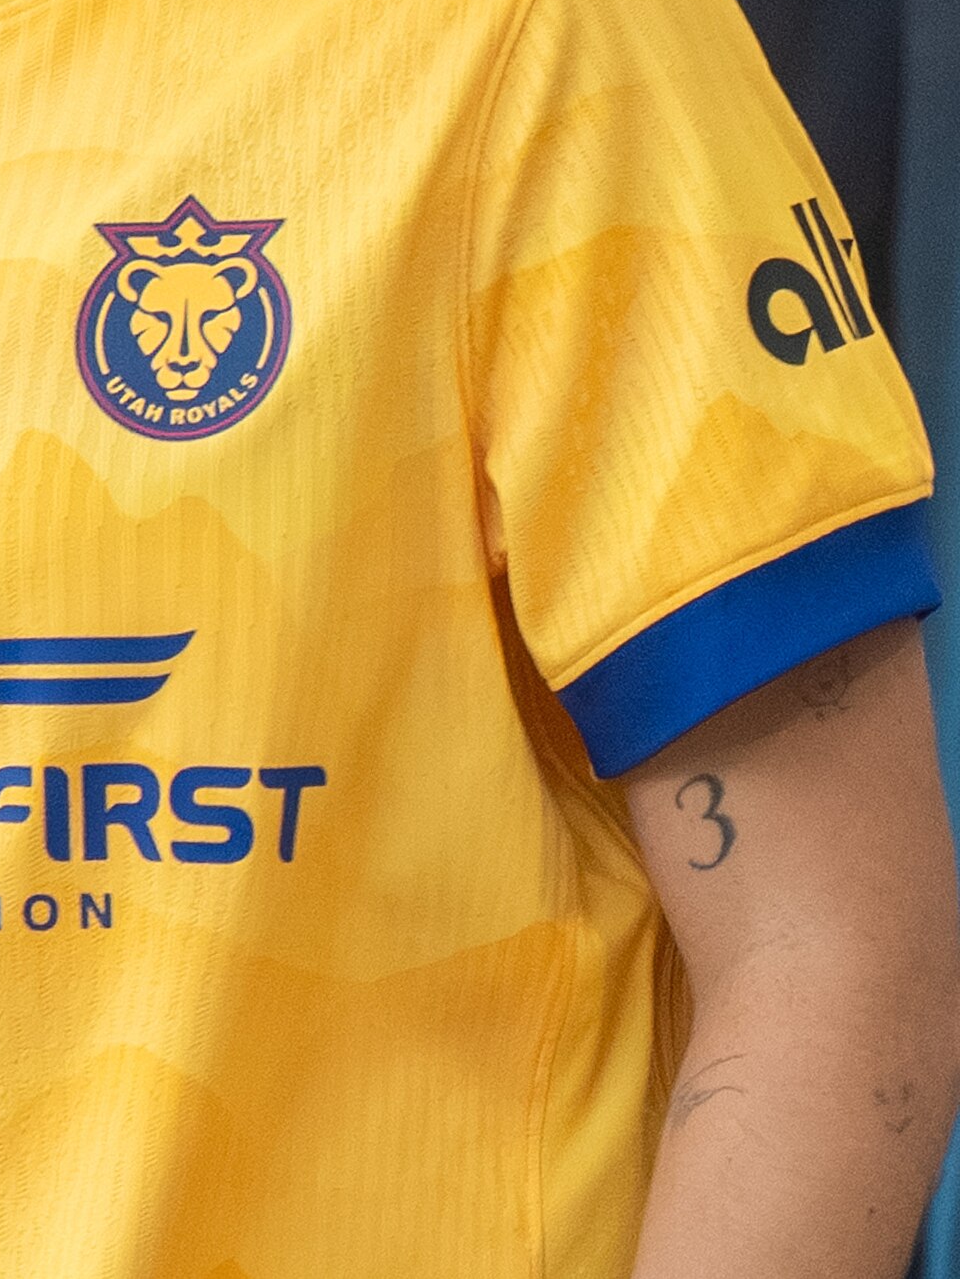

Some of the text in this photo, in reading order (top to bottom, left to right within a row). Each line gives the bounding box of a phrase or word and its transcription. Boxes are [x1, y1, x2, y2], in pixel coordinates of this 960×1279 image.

[746, 196, 876, 366] all
[104, 372, 259, 426] UTAH ROYALS
[675, 772, 738, 871] 3
